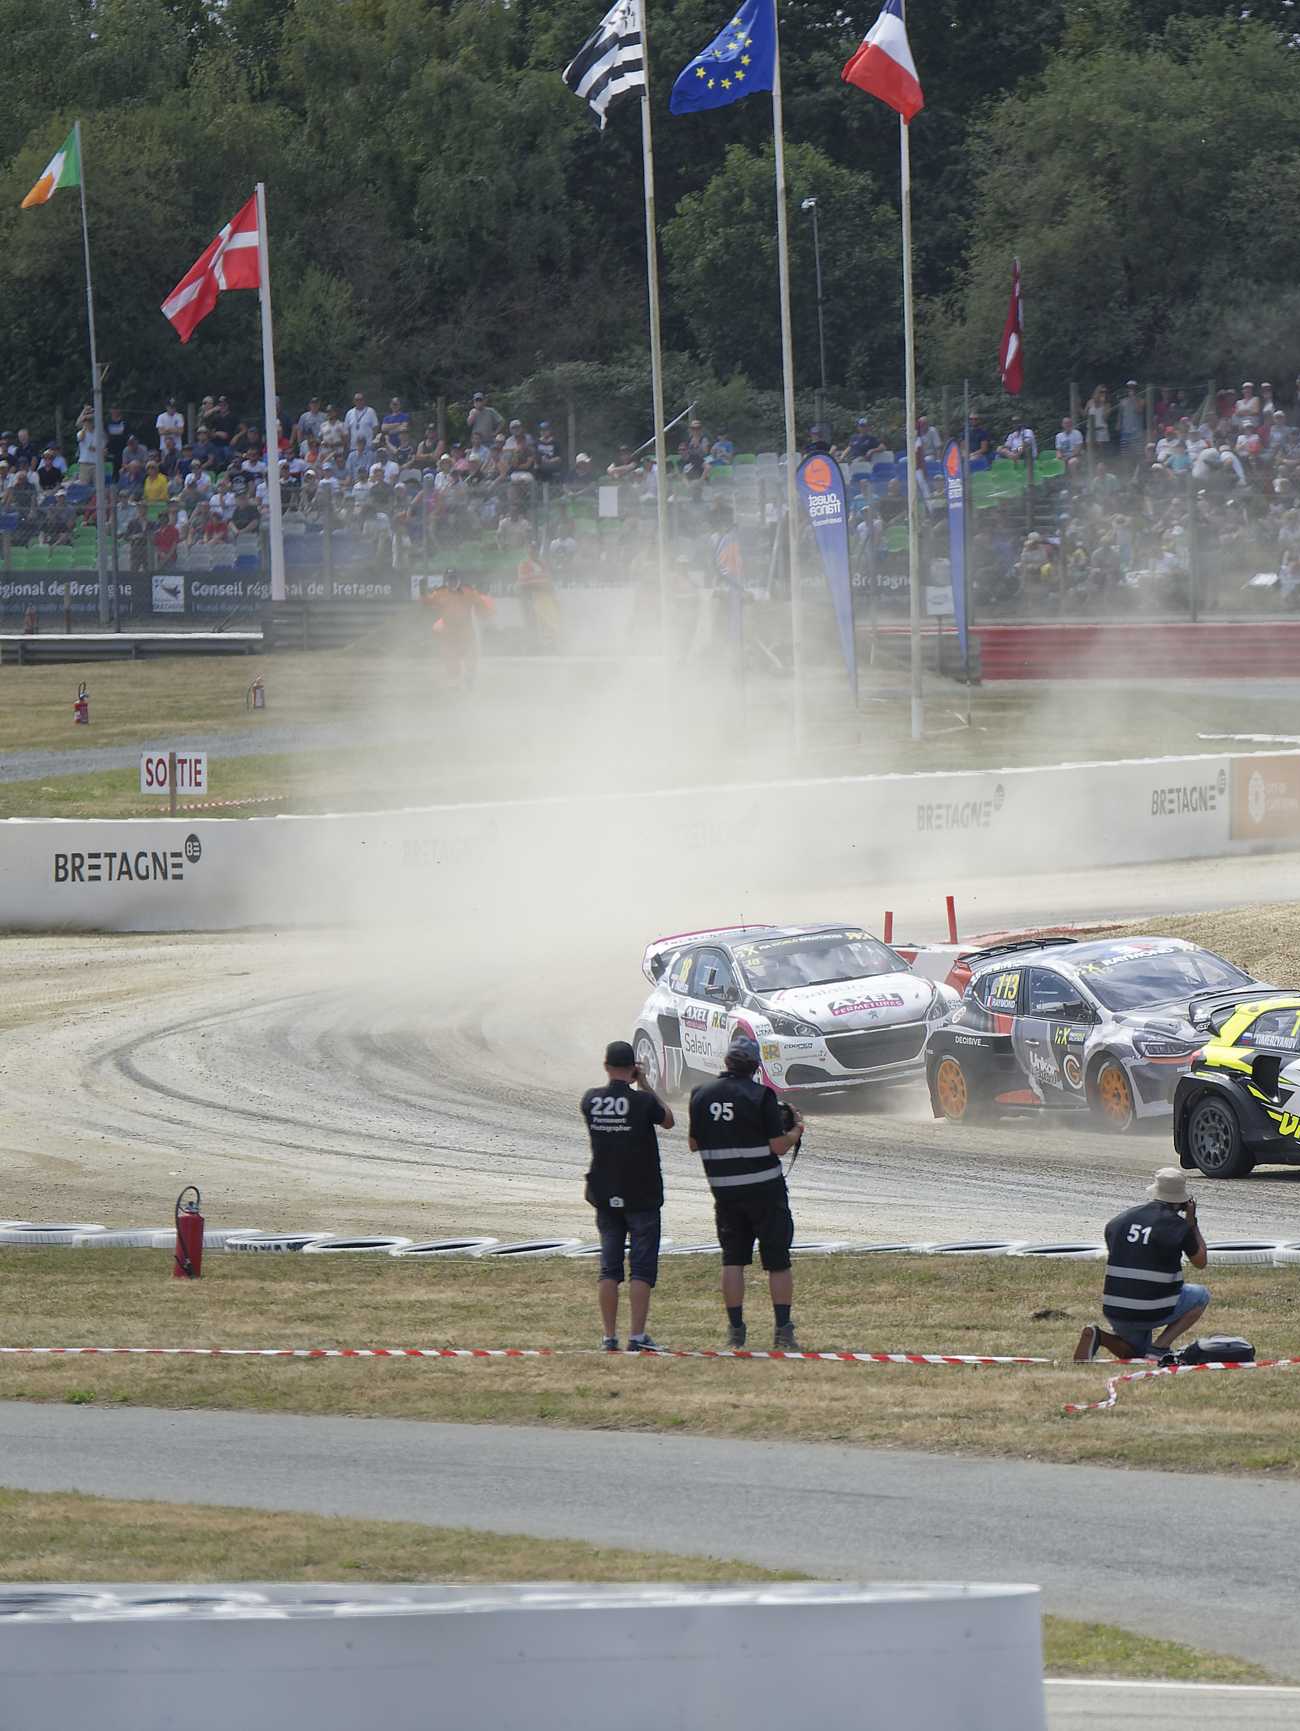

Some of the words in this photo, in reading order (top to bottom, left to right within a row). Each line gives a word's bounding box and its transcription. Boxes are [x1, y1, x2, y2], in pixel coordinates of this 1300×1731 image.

[48, 581, 65, 596] de
[191, 581, 243, 597] Conseil
[307, 583, 324, 595] de
[1150, 785, 1217, 816] BRETAGNE
[917, 801, 992, 831] BRETAGNE
[55, 851, 183, 882] BRETAGNE
[994, 974, 1020, 1000] 113
[684, 1032, 713, 1056] Salaün
[590, 1096, 630, 1116] 220
[709, 1102, 735, 1121] 95
[590, 1124, 632, 1133] Photographer
[1126, 1223, 1153, 1245] 51
